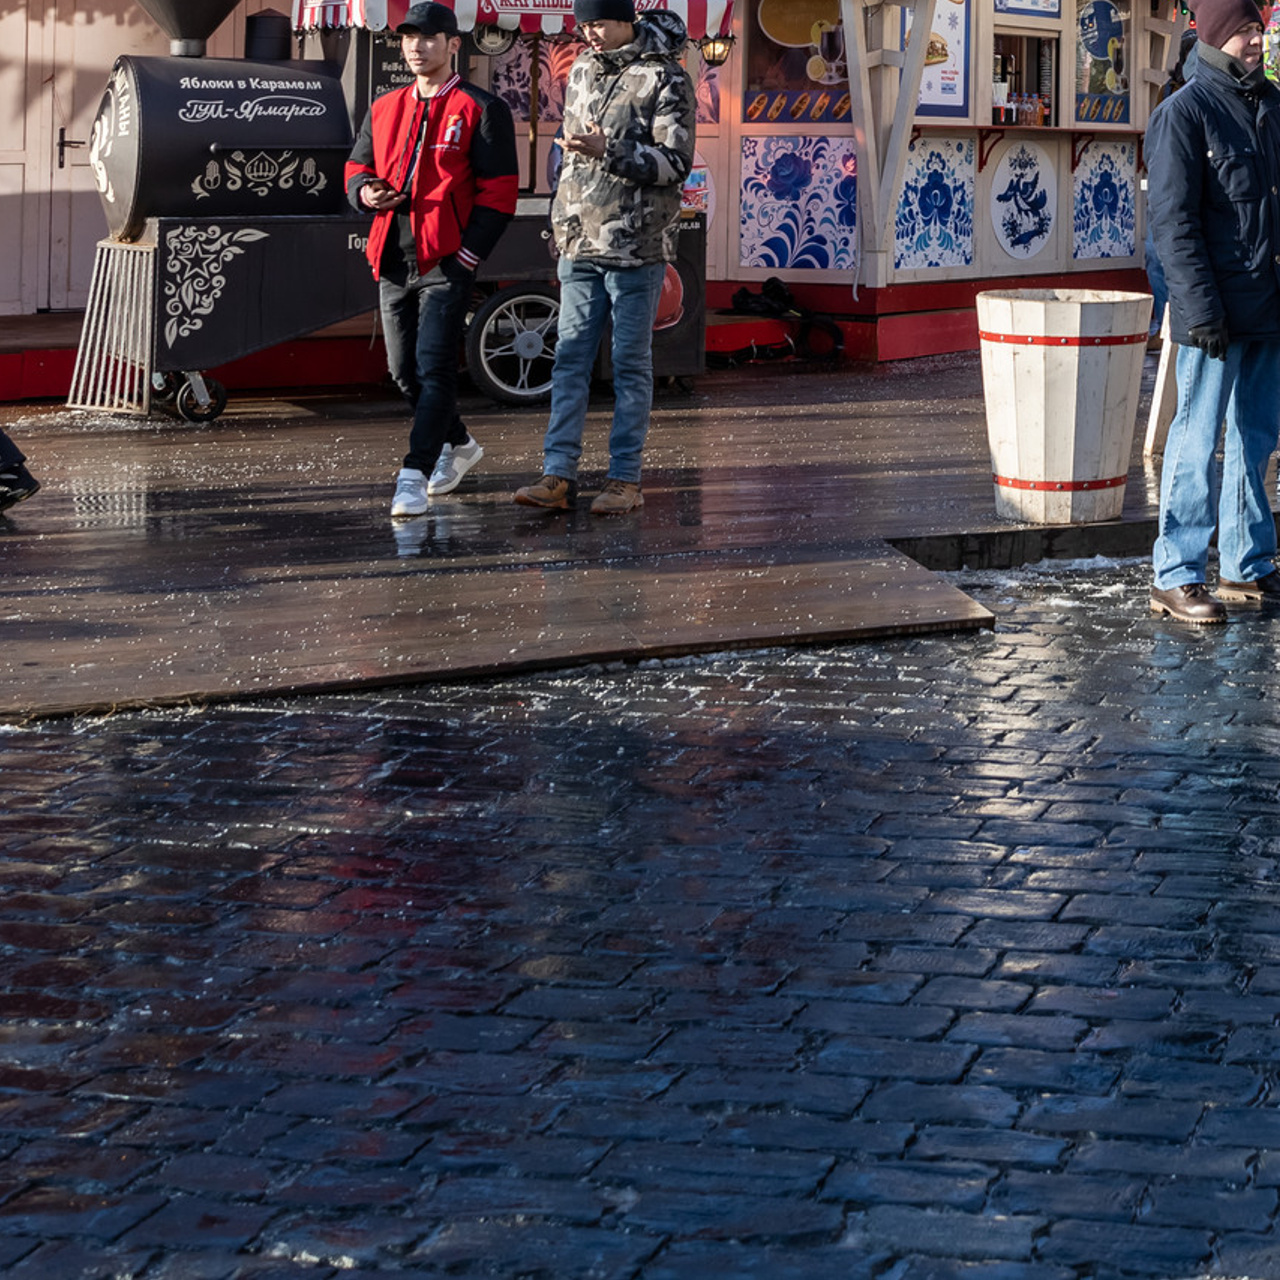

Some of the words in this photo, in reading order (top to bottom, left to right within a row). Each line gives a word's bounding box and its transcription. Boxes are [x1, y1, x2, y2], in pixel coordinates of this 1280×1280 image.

[179, 77, 235, 89] Яблоки
[237, 80, 247, 89] в
[249, 78, 322, 92] Карамели
